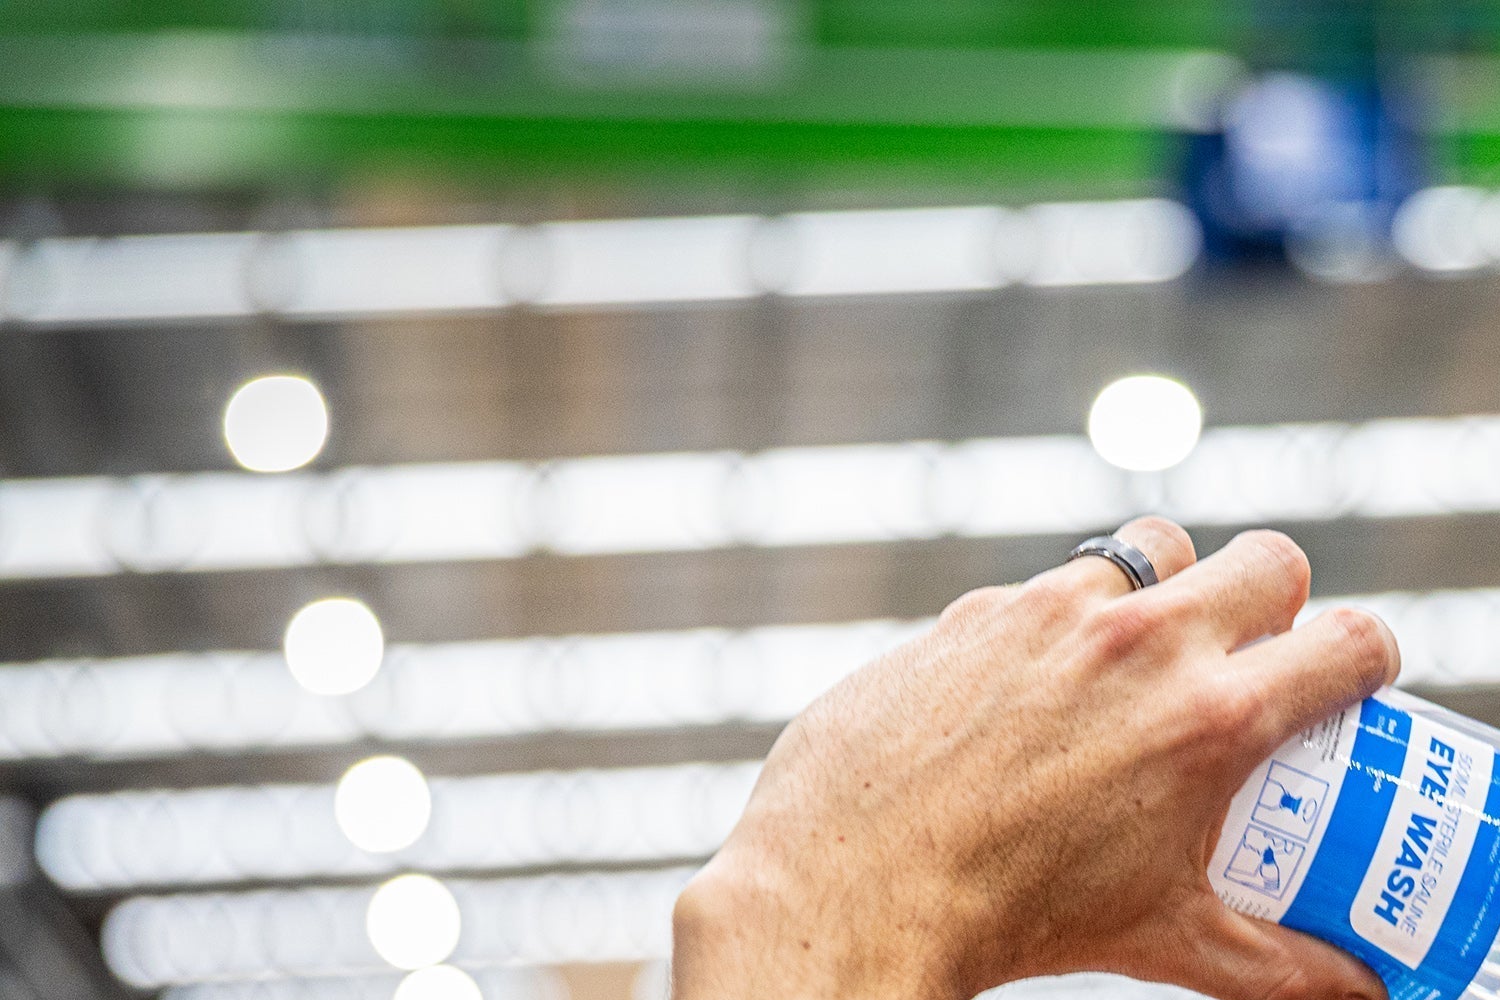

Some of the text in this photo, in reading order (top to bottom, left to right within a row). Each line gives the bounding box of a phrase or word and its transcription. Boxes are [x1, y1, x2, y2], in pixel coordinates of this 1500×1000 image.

[1419, 735, 1455, 807] EYE
[1373, 813, 1437, 926] WASH
[1427, 804, 1461, 874] STERILE
[1400, 872, 1437, 937] SALINE
